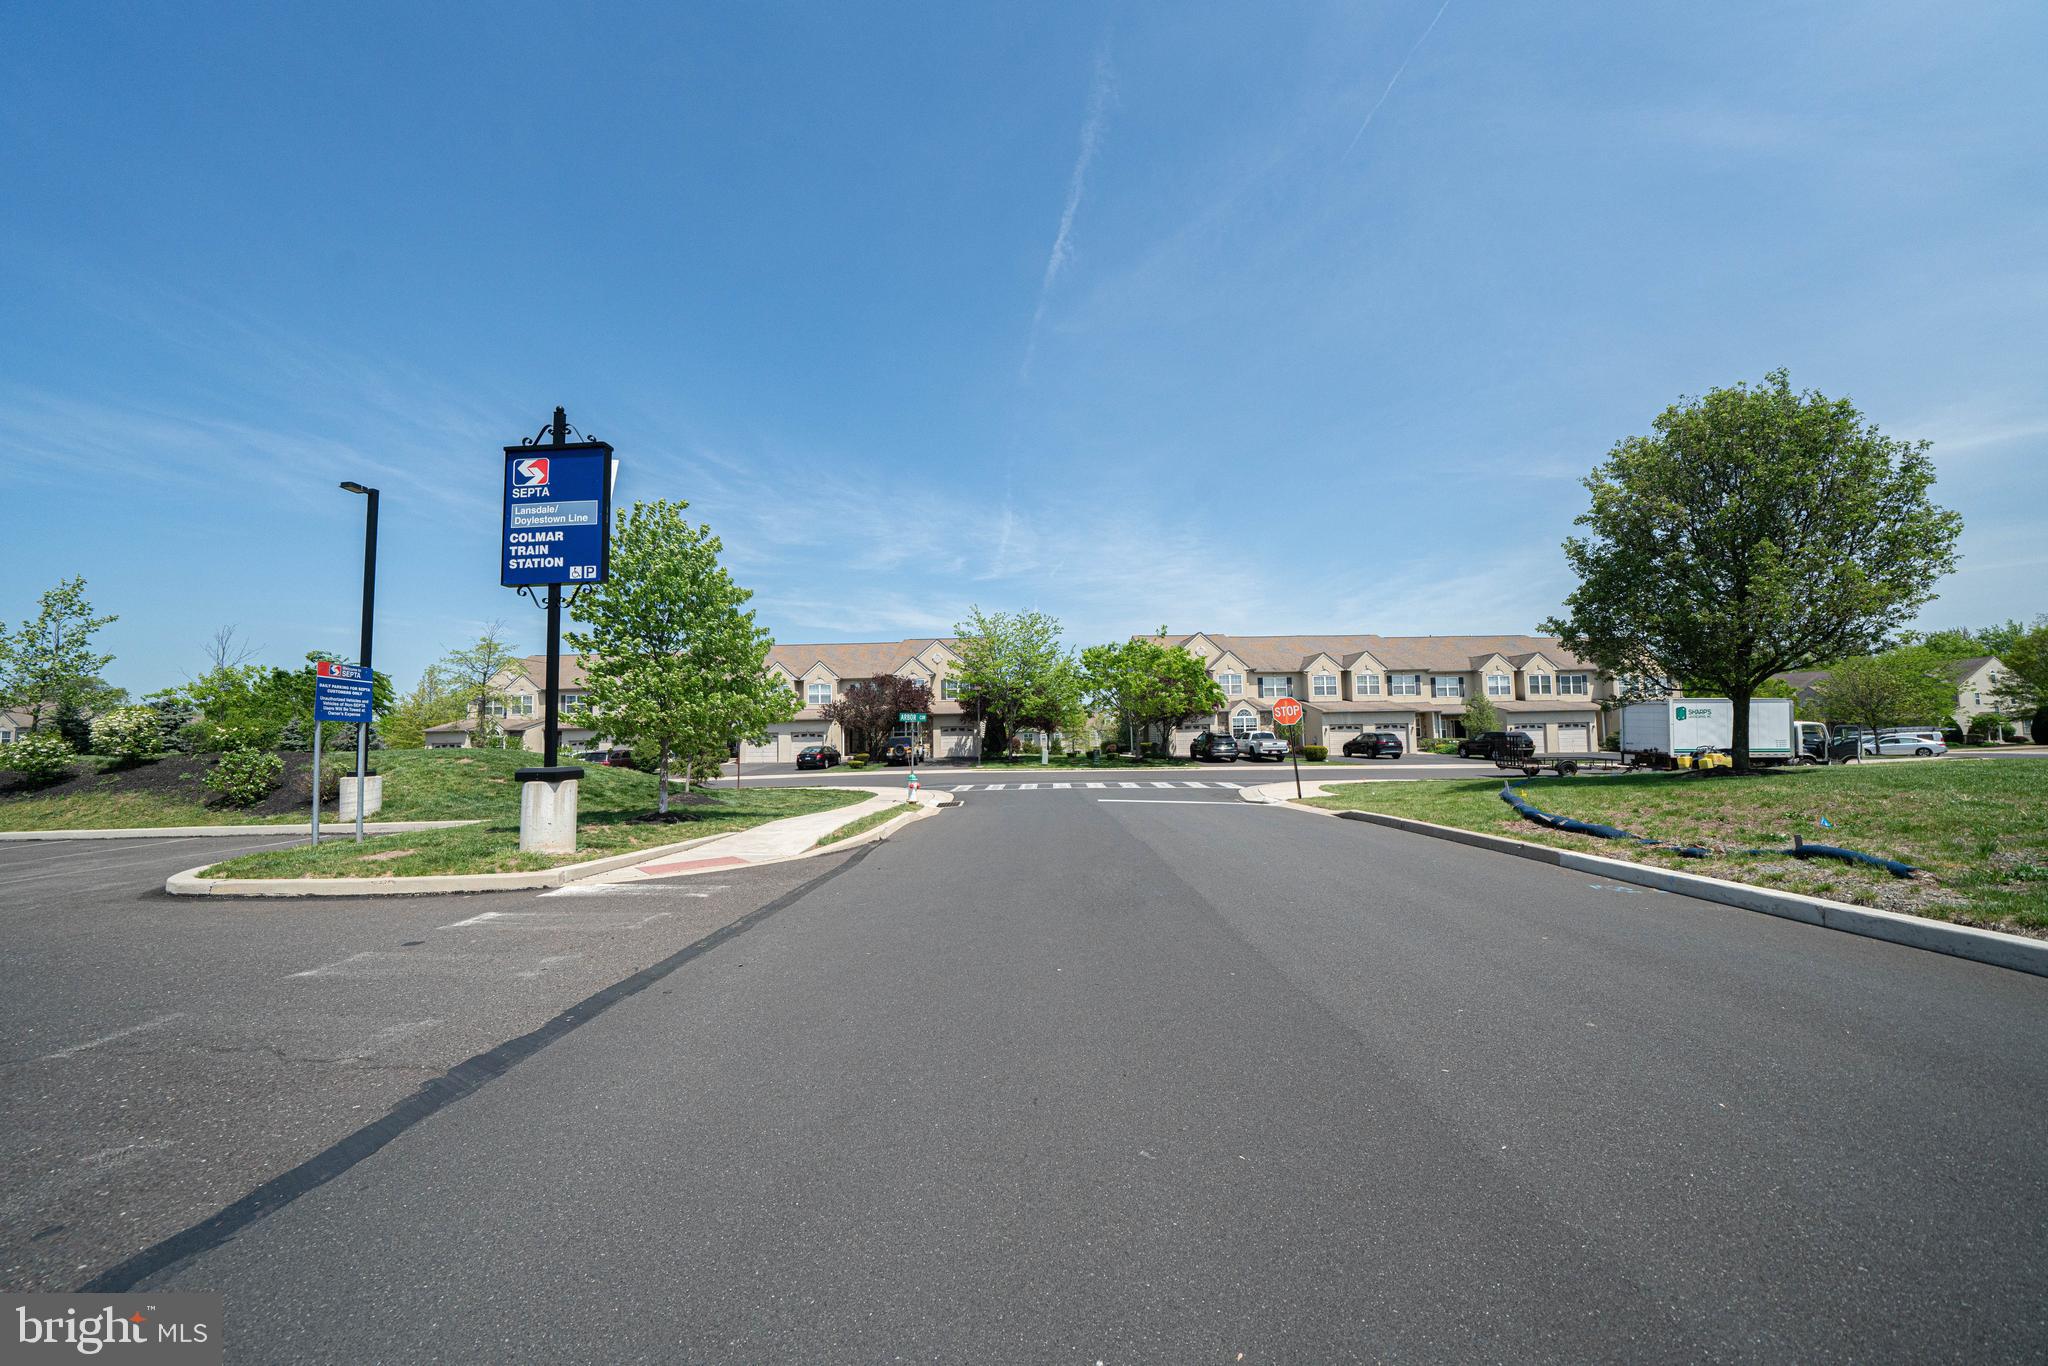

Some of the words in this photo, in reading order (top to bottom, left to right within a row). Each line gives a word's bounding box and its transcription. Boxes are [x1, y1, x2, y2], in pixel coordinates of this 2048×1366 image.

[512, 487, 550, 498] SEPTA
[514, 505, 559, 515] Lansdale/
[514, 515, 566, 526] Doylestown
[568, 514, 588, 522] Line
[509, 531, 564, 543] COLMAR
[509, 545, 549, 556] TRAIN
[509, 557, 564, 569] STATION
[586, 567, 595, 577] P
[1274, 705, 1300, 717] STOP
[900, 713, 917, 721] ARBOR
